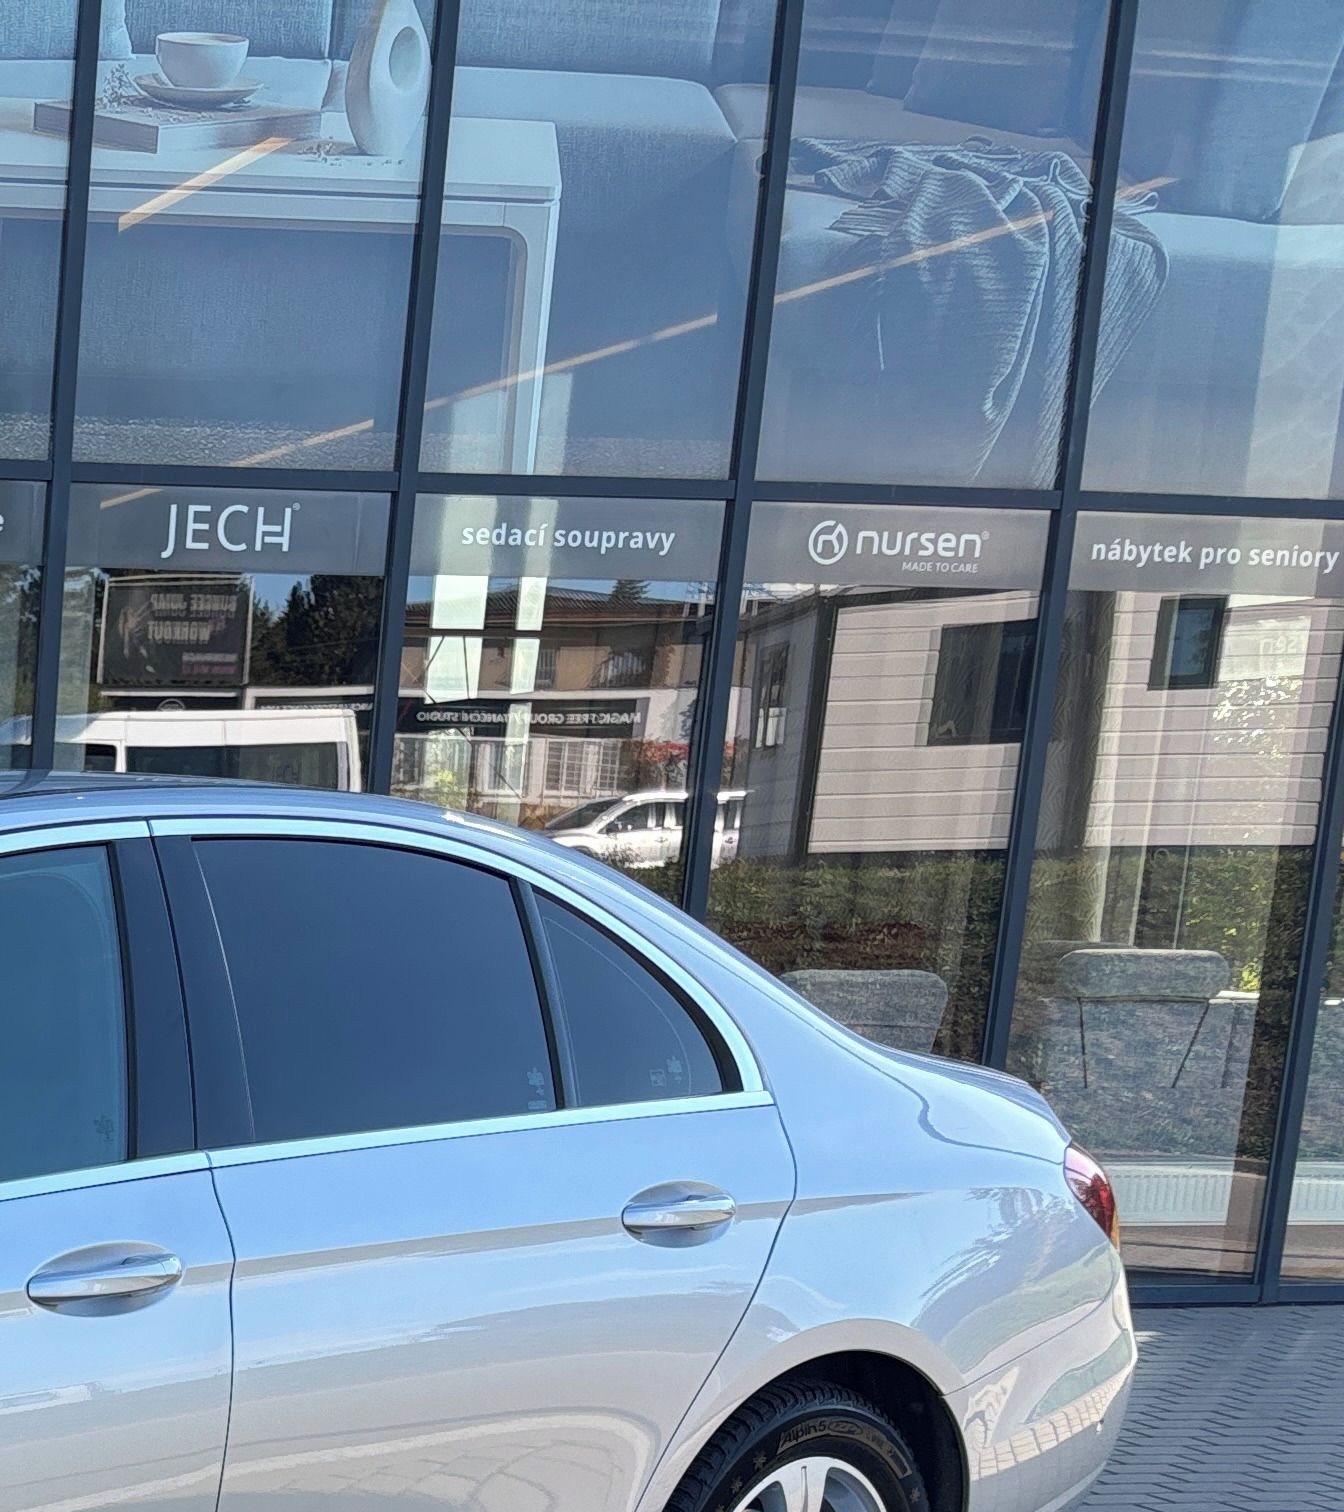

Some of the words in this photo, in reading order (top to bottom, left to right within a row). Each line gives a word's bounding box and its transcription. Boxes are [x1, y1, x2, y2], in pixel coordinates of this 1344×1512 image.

[160, 503, 293, 559] JECH
[461, 519, 545, 547] sedací
[553, 526, 676, 556] soupravy
[855, 530, 982, 558] nursen
[902, 561, 932, 572] MADE
[935, 562, 950, 573] TO
[951, 562, 979, 574] CARE
[1091, 537, 1193, 567] nábytek
[1199, 546, 1242, 570] pro
[1248, 545, 1340, 575] seniory
